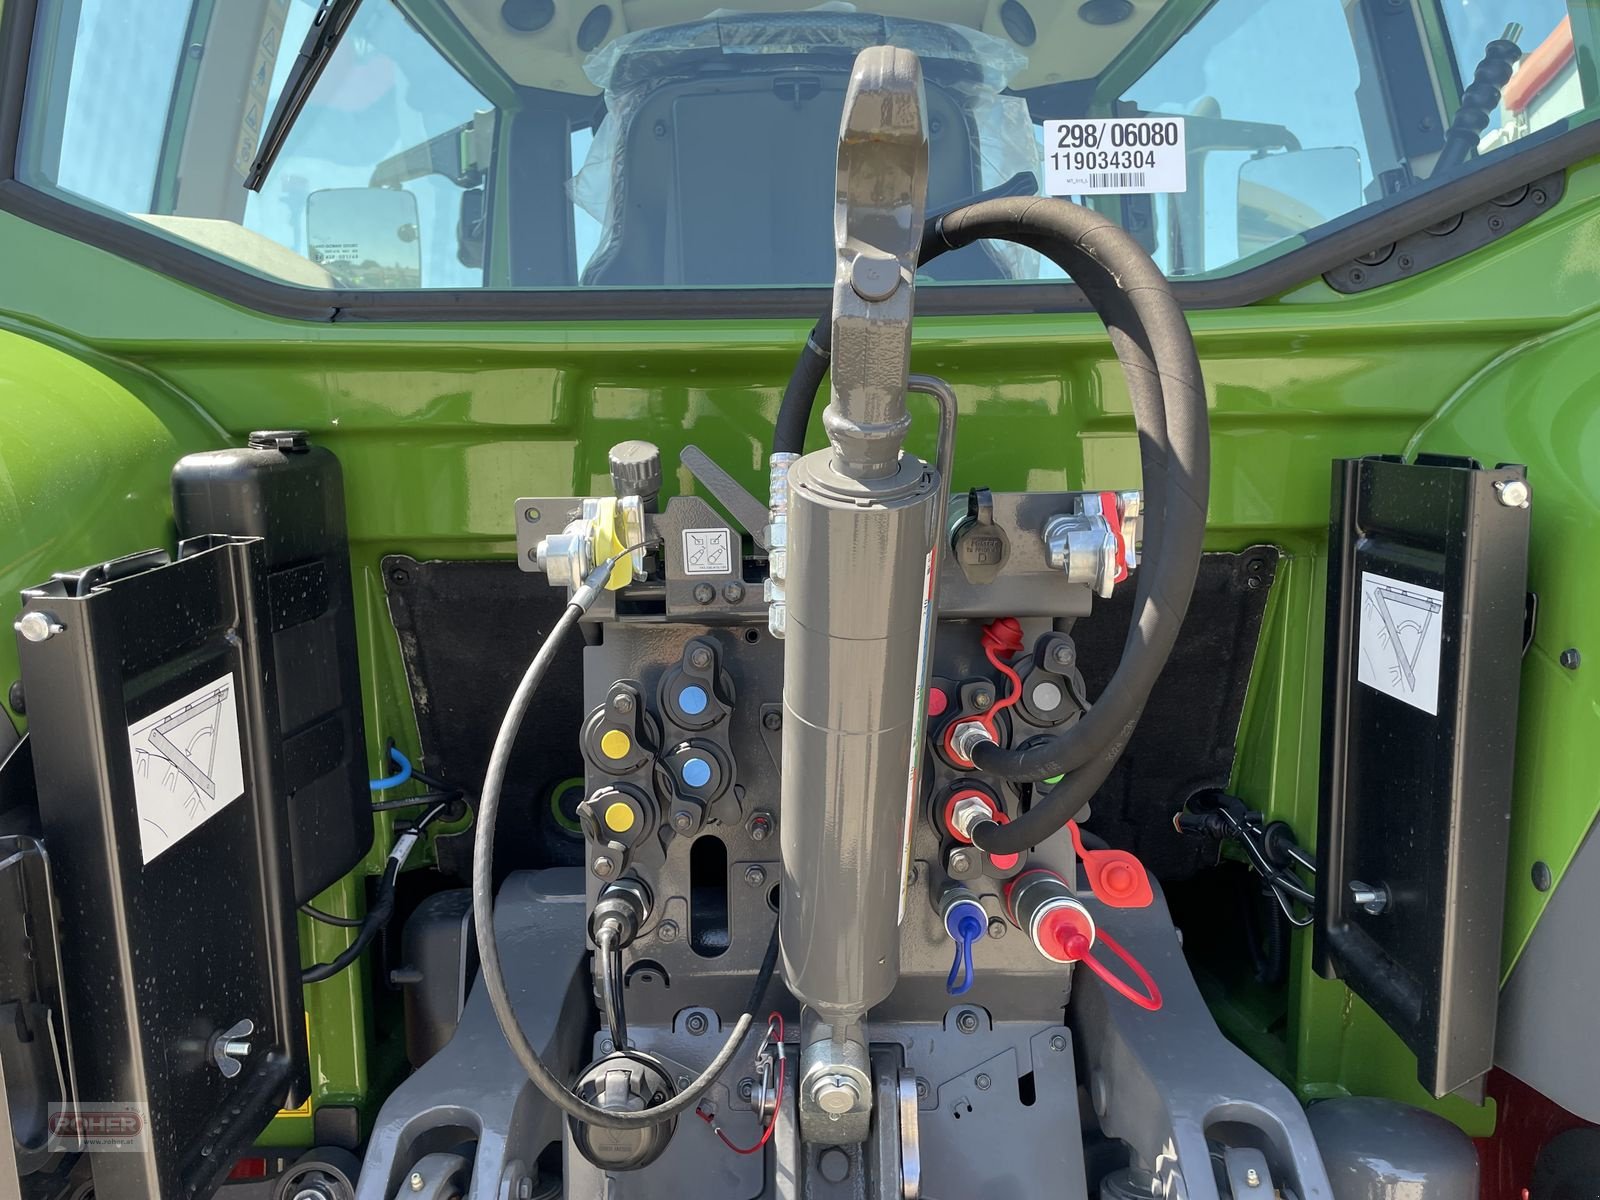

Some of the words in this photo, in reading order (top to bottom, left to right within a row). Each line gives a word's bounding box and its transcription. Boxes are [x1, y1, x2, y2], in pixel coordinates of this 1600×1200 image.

[1057, 123, 1106, 149] 298/
[1110, 122, 1178, 148] 06080
[1050, 150, 1156, 171] 119034304
